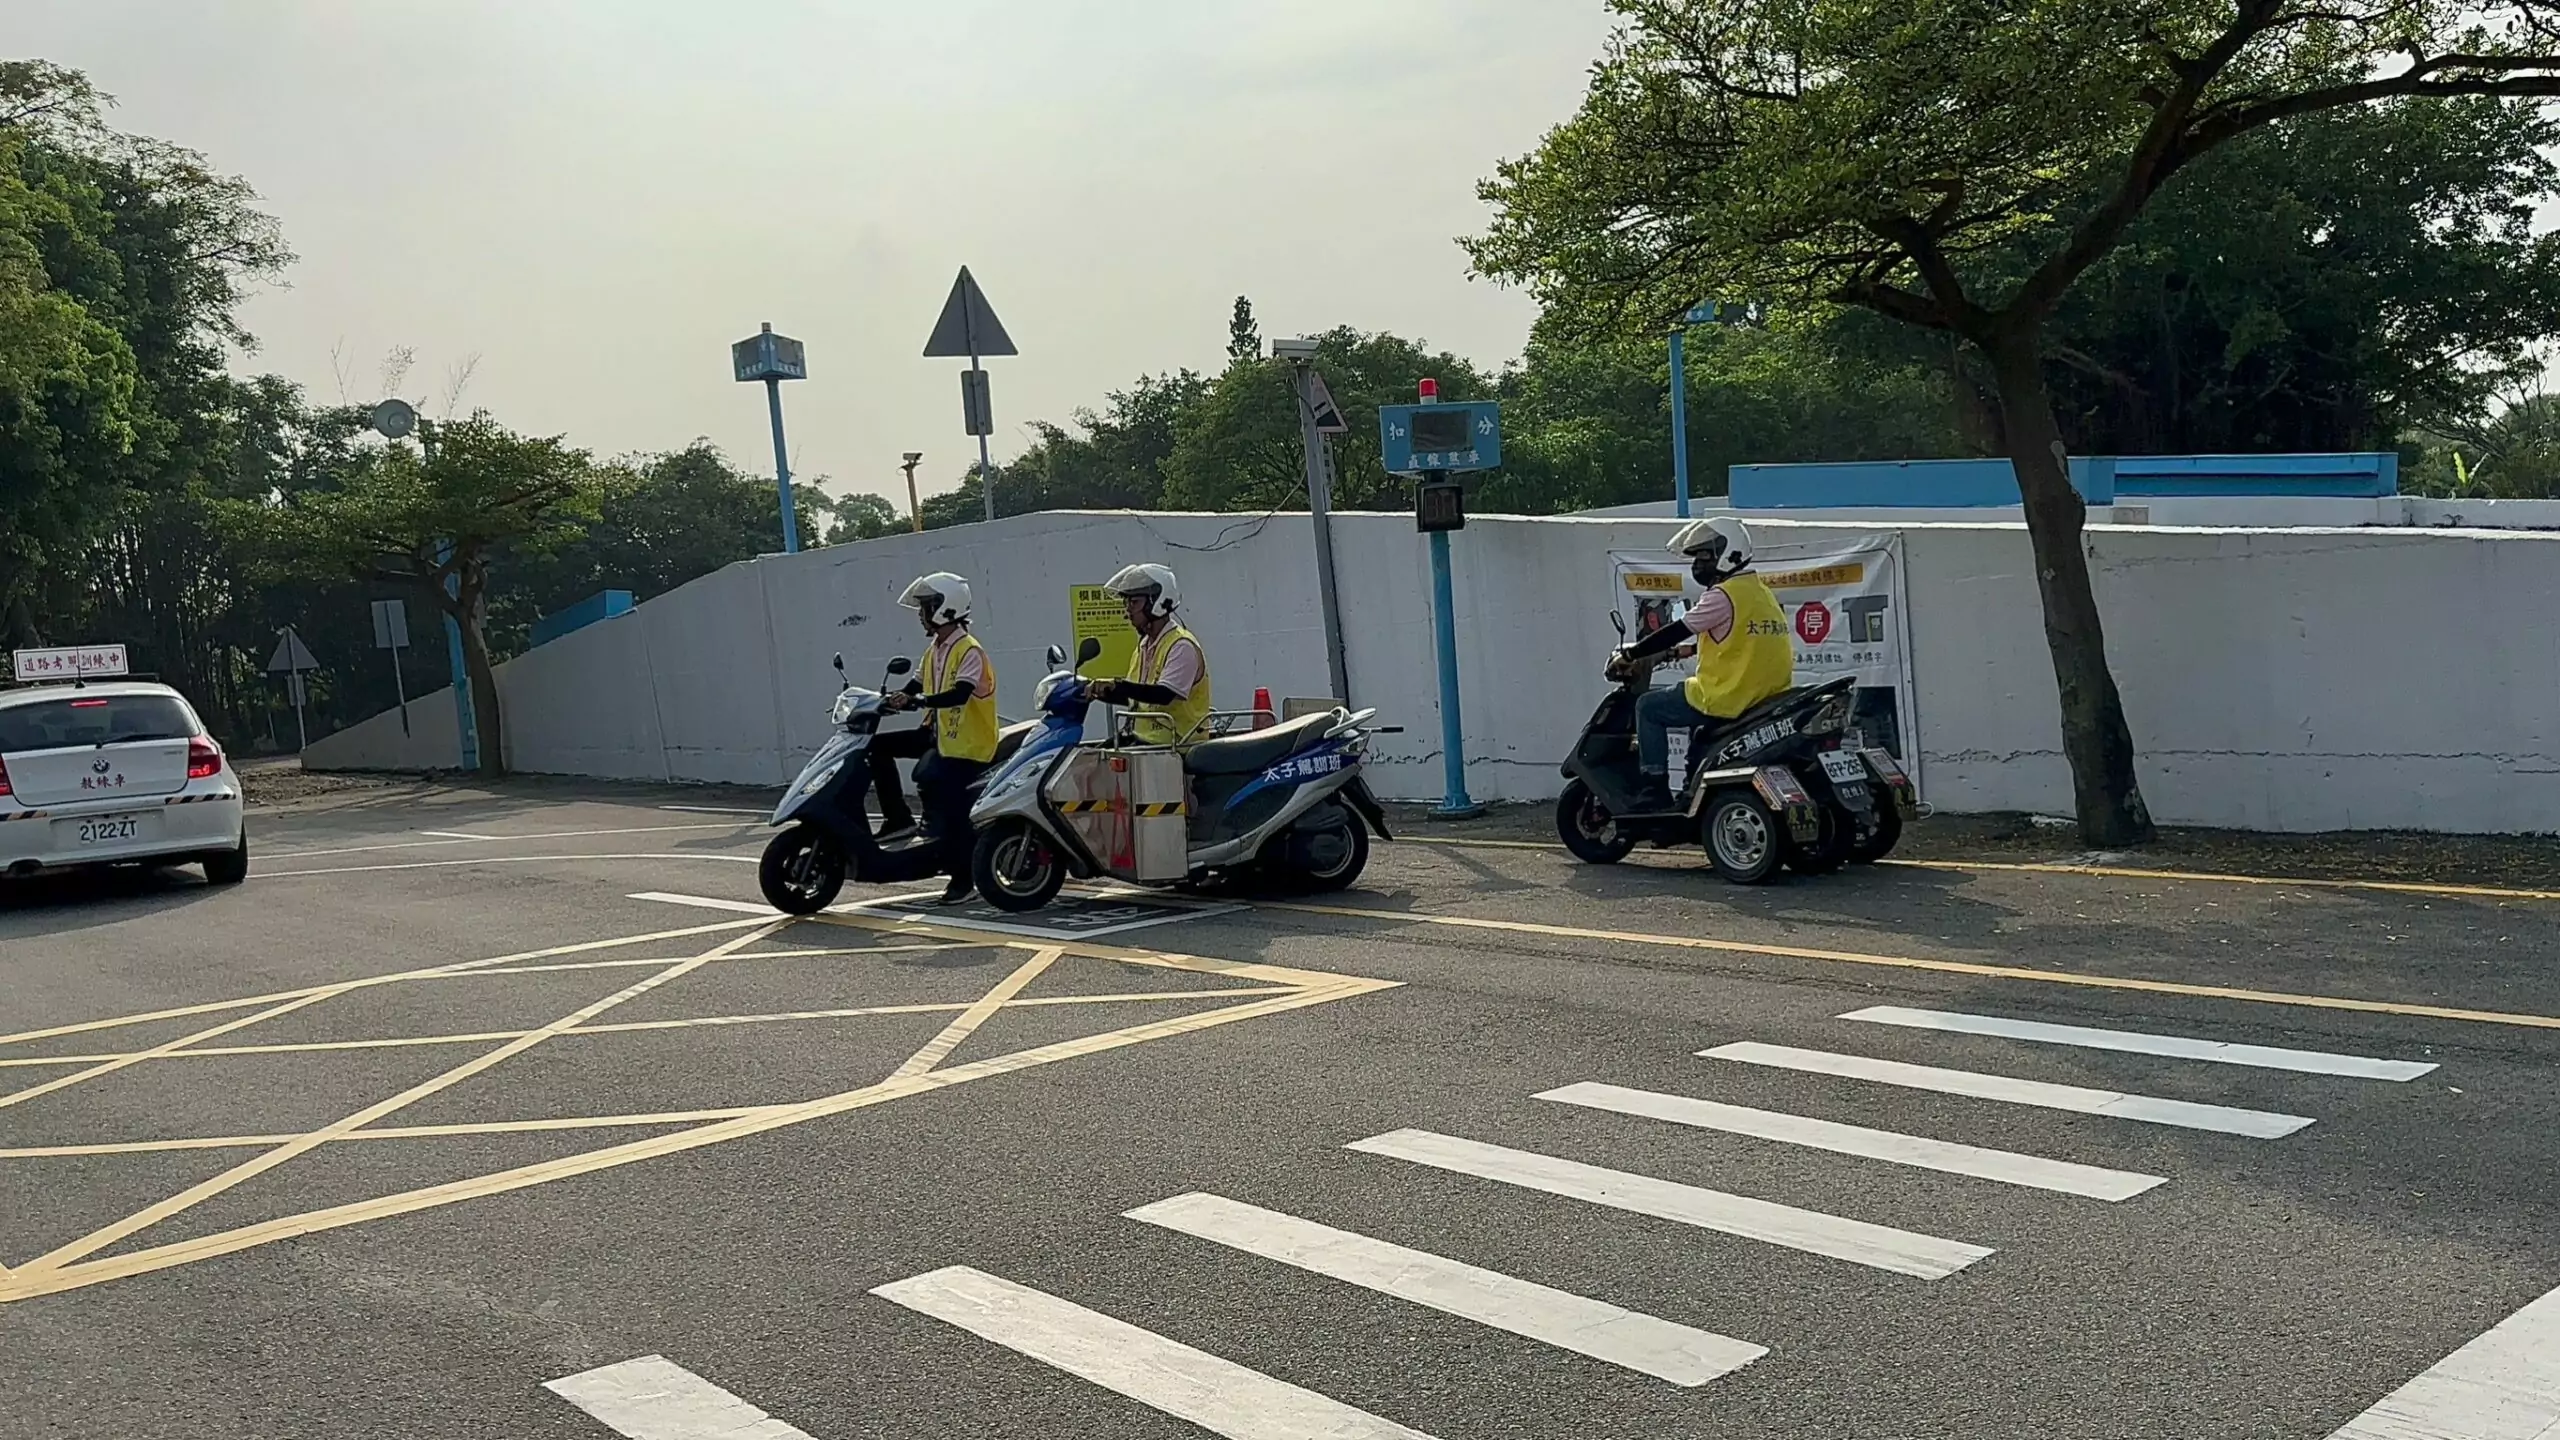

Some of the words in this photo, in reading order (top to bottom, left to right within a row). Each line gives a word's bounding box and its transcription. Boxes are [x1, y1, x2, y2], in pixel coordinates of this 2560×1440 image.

[1478, 415, 1494, 436] 分
[1803, 610, 1824, 635] 停
[1718, 717, 1797, 765] 太子駕訓班
[1262, 754, 1340, 782] 太子駕訓班
[81, 774, 125, 789] 教練車
[80, 820, 136, 840] 2122-ZT
